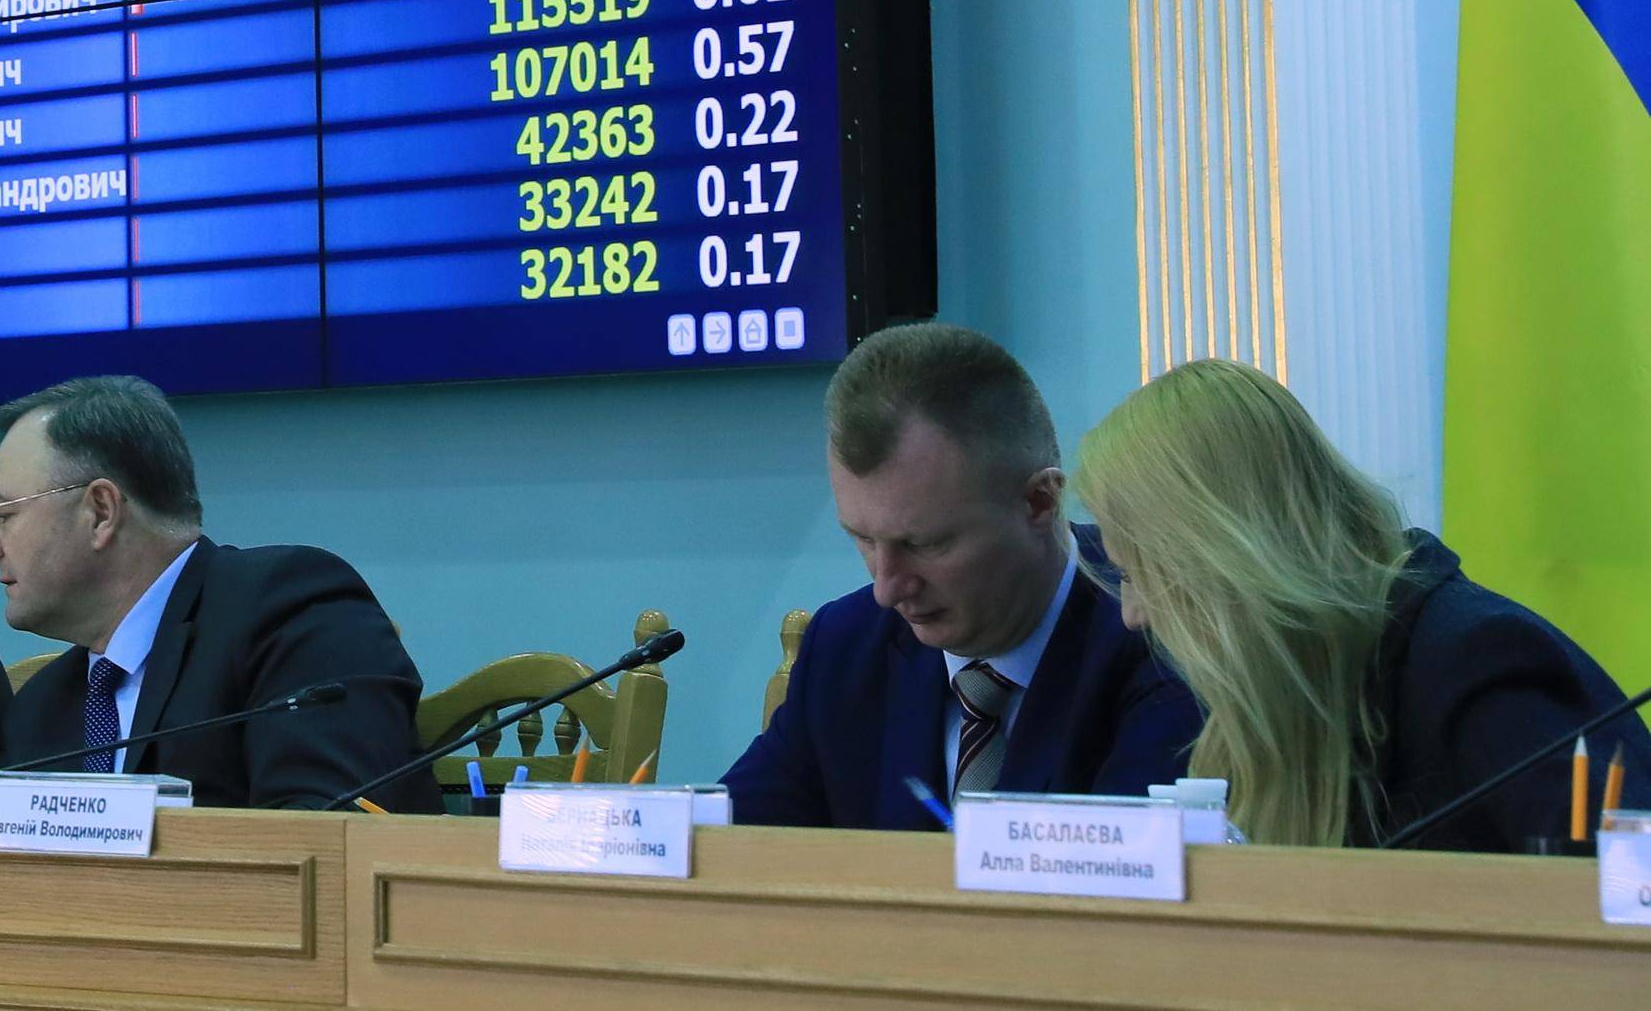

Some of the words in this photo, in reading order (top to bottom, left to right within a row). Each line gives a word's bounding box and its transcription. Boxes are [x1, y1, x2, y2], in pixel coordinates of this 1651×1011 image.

[490, 36, 654, 101] 107014
[692, 20, 794, 79] 0.57
[515, 103, 655, 165] 42363
[694, 89, 798, 149] 0.22
[519, 171, 658, 231] 33242
[697, 159, 798, 217] 0.17
[520, 240, 659, 299] 32182
[698, 230, 800, 287] 0.17
[30, 794, 107, 814] РАДЧЕНКО
[40, 820, 143, 843] Володимирович
[1008, 821, 1124, 845] БАСАЛАЄВА
[980, 851, 1024, 872] Алла
[1030, 853, 1155, 879] Валентинівна
